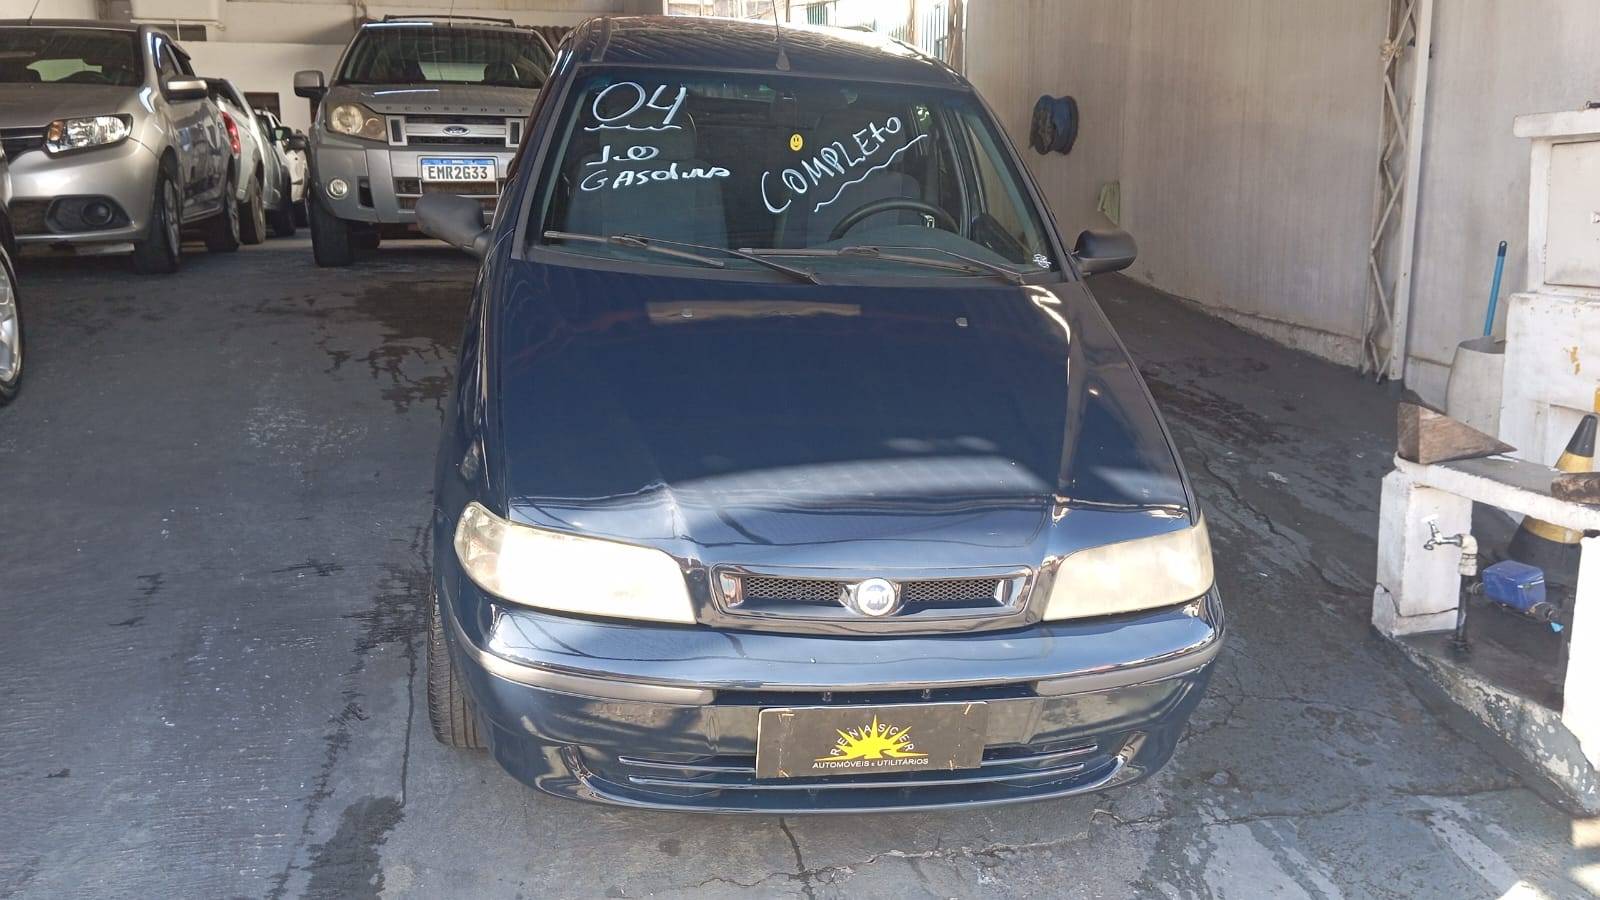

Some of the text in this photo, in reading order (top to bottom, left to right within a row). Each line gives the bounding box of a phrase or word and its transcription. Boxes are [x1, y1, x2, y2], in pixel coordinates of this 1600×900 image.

[593, 81, 687, 124] 04
[428, 166, 488, 180] EMR2G33
[830, 723, 914, 756] RENASCER
[812, 759, 869, 769] AUTOMÓVEIS
[877, 758, 929, 767] UTILITÁRIOS
